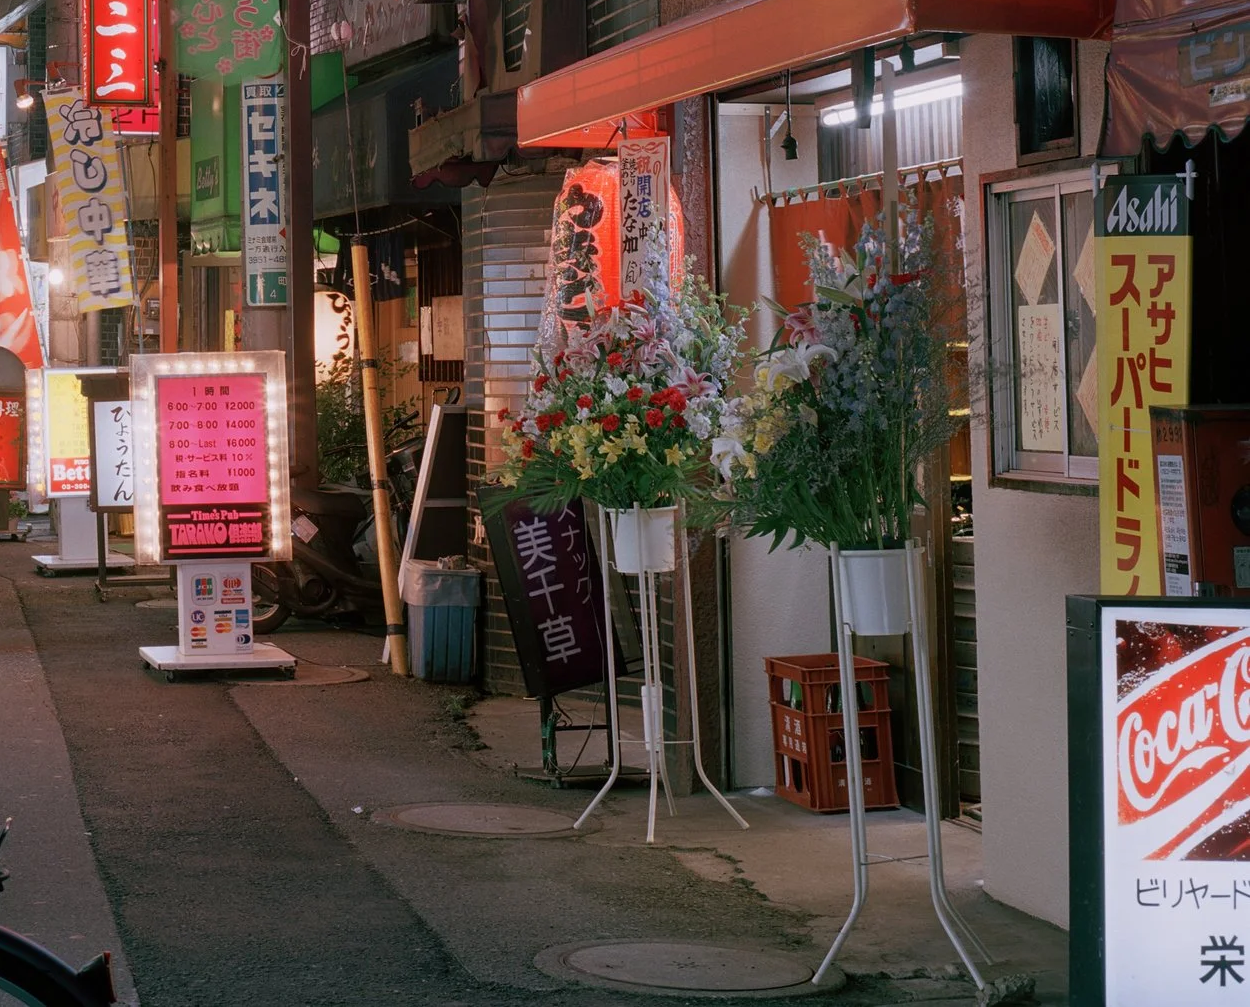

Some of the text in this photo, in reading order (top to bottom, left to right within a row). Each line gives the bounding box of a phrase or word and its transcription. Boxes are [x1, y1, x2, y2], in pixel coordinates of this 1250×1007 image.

[248, 110, 279, 219] セキネ
[59, 99, 121, 298] 冷し中華
[622, 189, 639, 254] たな加
[1107, 184, 1178, 234] Asahi
[1147, 253, 1177, 394] アサヒ
[110, 406, 135, 502] ひょうたん
[169, 522, 228, 546] TARAKO
[191, 510, 240, 521] Time's Pub
[514, 517, 582, 664] 美千草
[1136, 877, 1250, 910] ビリヤード
[1198, 934, 1246, 987] 栄
